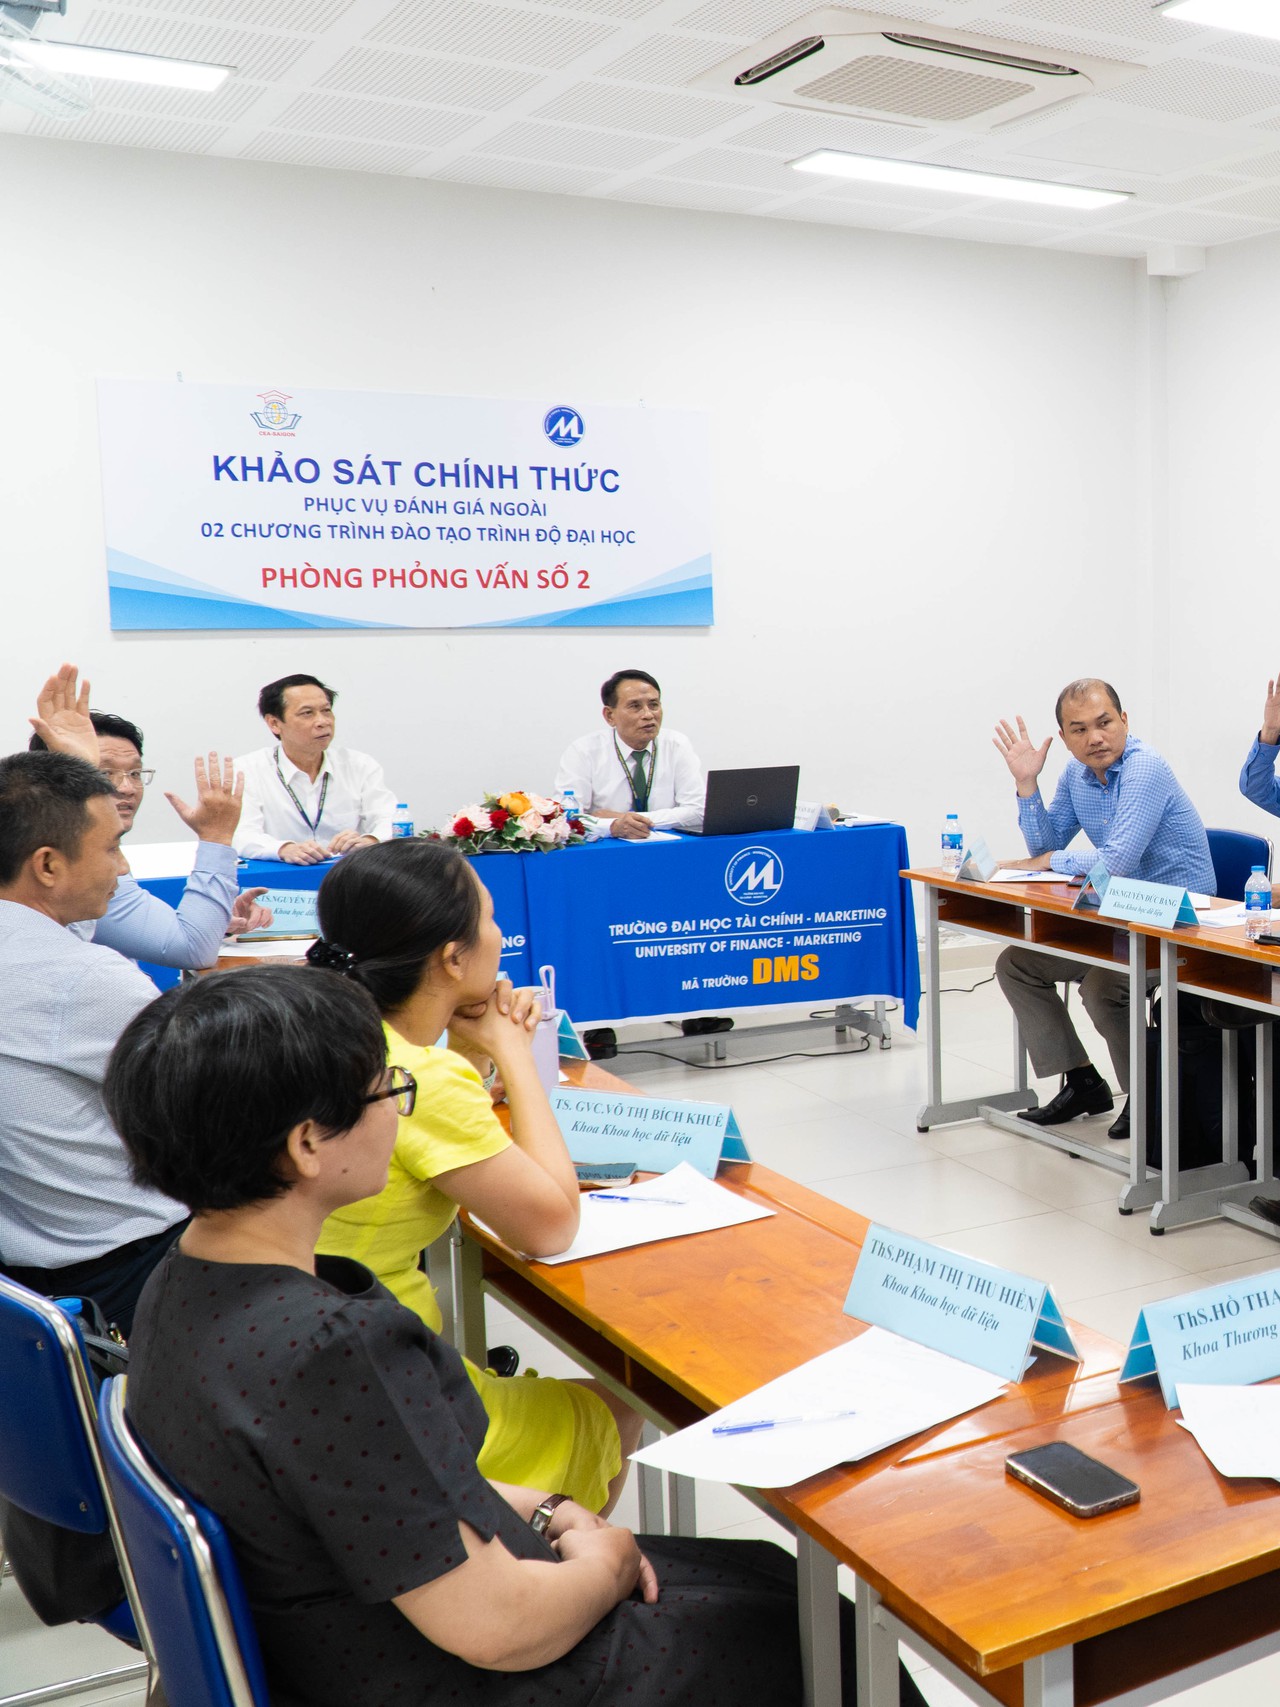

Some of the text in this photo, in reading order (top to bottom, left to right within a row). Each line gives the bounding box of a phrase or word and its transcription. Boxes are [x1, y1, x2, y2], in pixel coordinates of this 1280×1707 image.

[213, 451, 620, 493] KHẢO SÁT CHÍNH THỨC
[304, 496, 547, 516] PHỤC VỤ ĐÁNH GIÁ NGOÀI
[201, 521, 636, 546] 02 CHƯƠNG TRÌNH ĐÀO TẠO TRÌNH ĐỘ ĐẠI HỌC
[261, 561, 590, 589] PHÒNG PHỎNG VẤN SỐ 2
[609, 920, 668, 937] TRƯỜNG
[671, 920, 696, 935] ĐẠI
[700, 917, 732, 933] HỌC
[735, 914, 757, 928] TÀI
[760, 911, 804, 927] CHÍNH
[814, 908, 887, 923] MARKETING
[635, 942, 706, 958] UNIVERSITY
[710, 940, 726, 953] OF
[730, 937, 783, 951] FINANCE
[793, 931, 862, 947] MARKETING
[682, 953, 820, 990] MÃ TRƯỜNG DMS
[555, 1098, 724, 1127] TS. GVC.VÕ THỊ BÍCH KHUÊ
[571, 1120, 693, 1147] Khoa Khoa học dữ liệu
[870, 1238, 1038, 1313] ThS.PHẠM THỊ THU HIỀN
[881, 1274, 1000, 1331] Khoa Khoa học dữ liệu
[1173, 1294, 1240, 1331] ThS.HỒ
[1181, 1340, 1219, 1361] Khoa
[1222, 1323, 1278, 1348] Thương
